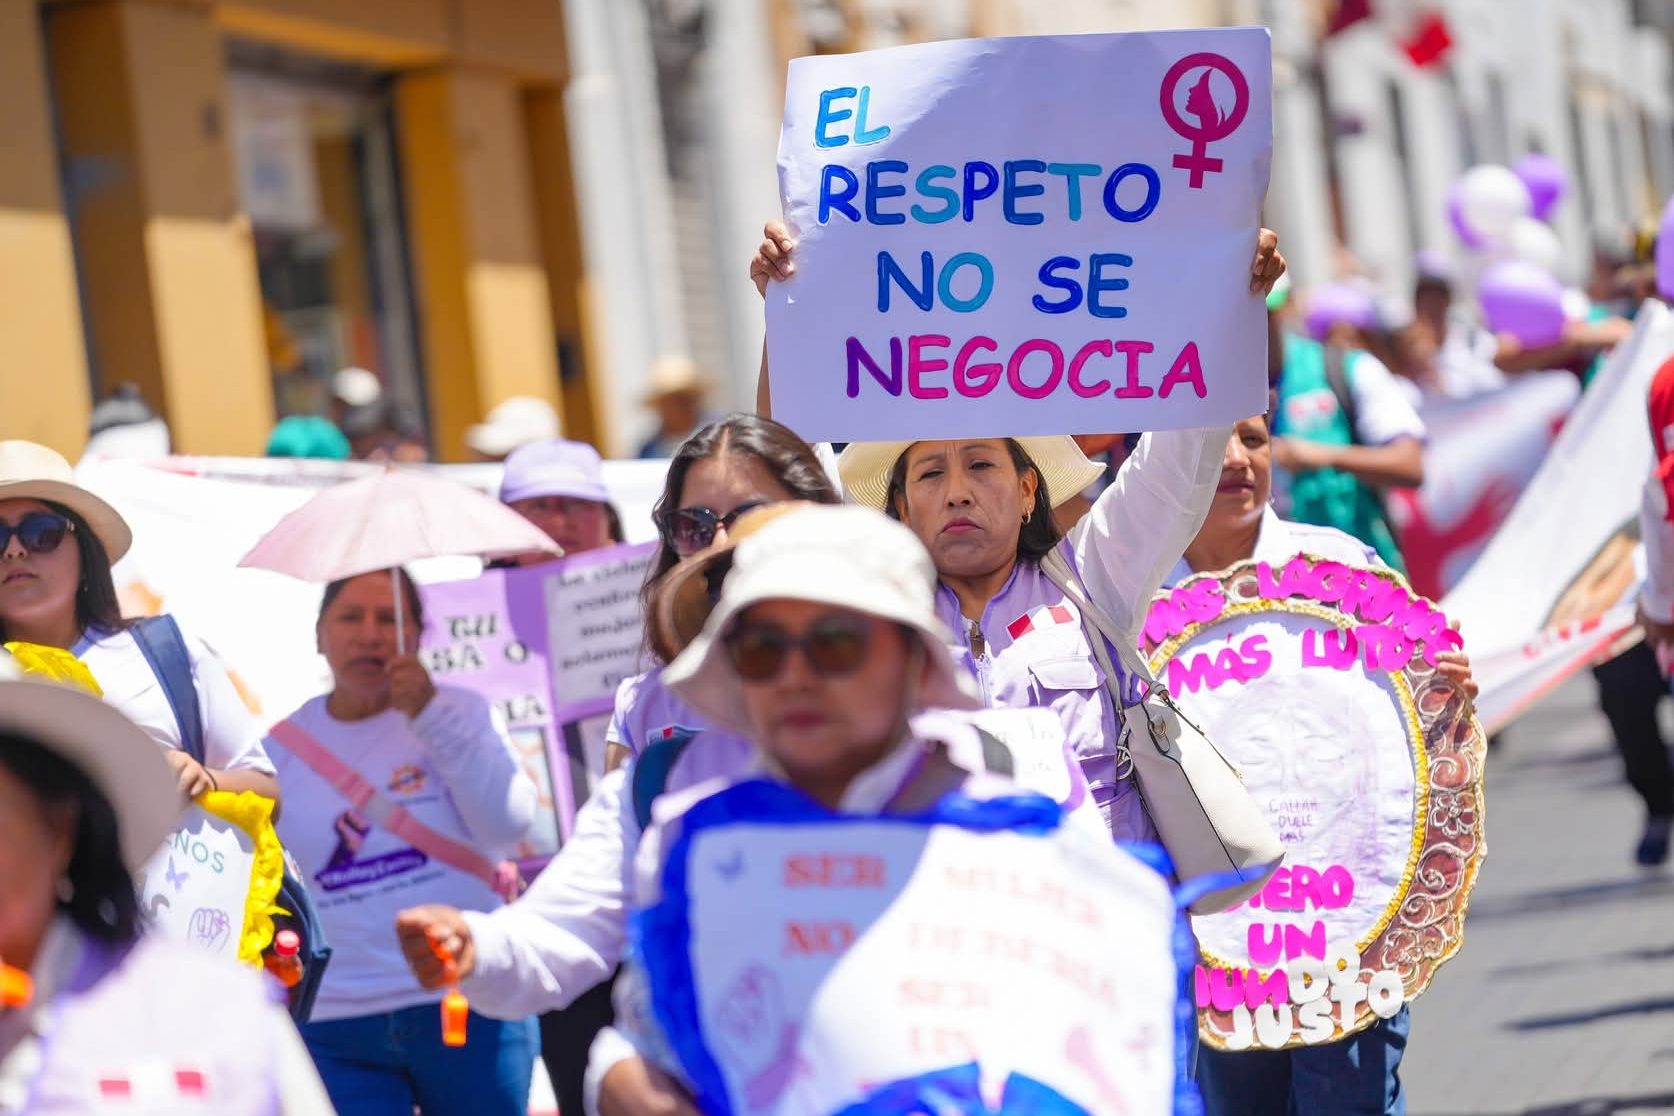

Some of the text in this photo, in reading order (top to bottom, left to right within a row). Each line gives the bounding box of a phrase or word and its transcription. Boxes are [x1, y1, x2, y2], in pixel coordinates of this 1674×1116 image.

[813, 84, 891, 149] EL
[817, 160, 1161, 226] RESPETO
[877, 250, 1133, 318] NO SE
[846, 334, 1208, 400] NEGOCIA
[1247, 920, 1327, 966] UN
[1225, 970, 1405, 1050] JUSTO
